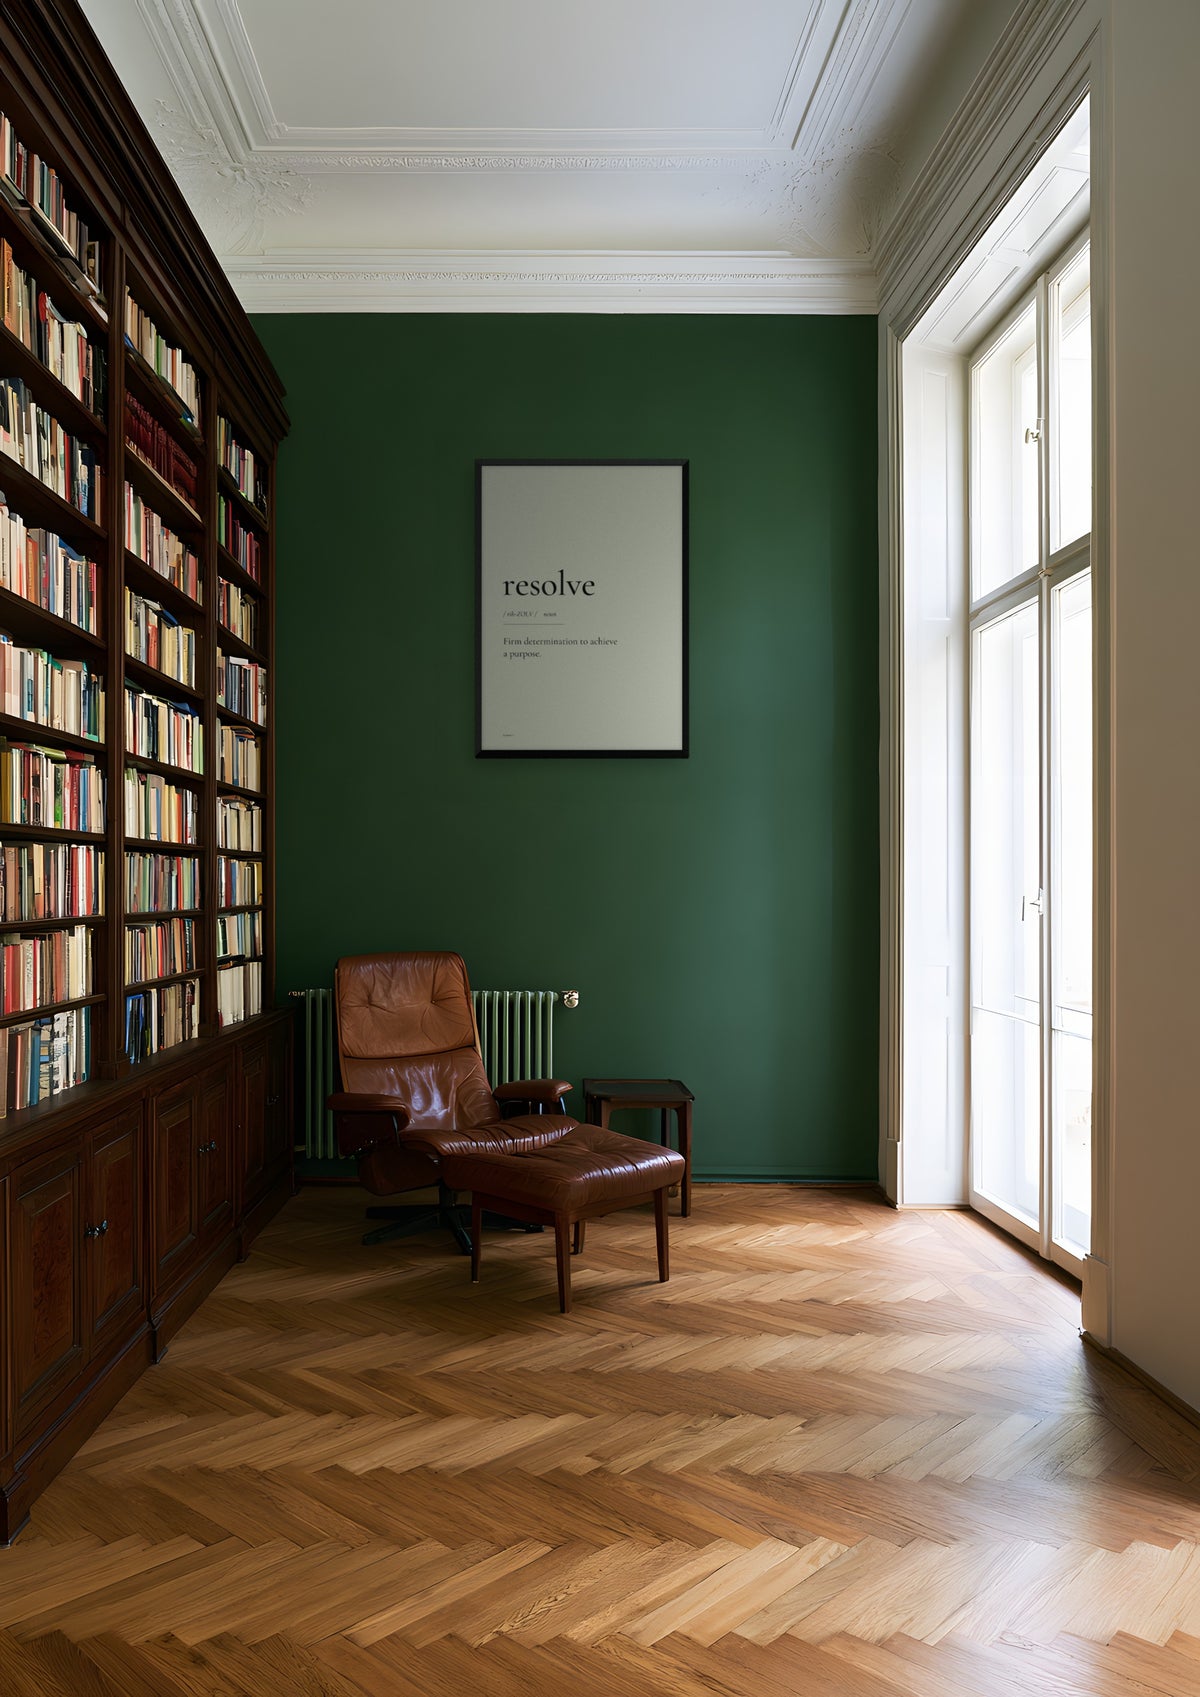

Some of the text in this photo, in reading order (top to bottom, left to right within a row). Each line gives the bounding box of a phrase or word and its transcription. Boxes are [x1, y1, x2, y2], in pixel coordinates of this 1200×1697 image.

[503, 569, 595, 597] resolve
[503, 636, 619, 646] Firm determination to achieve
[509, 651, 542, 660] purpose.
